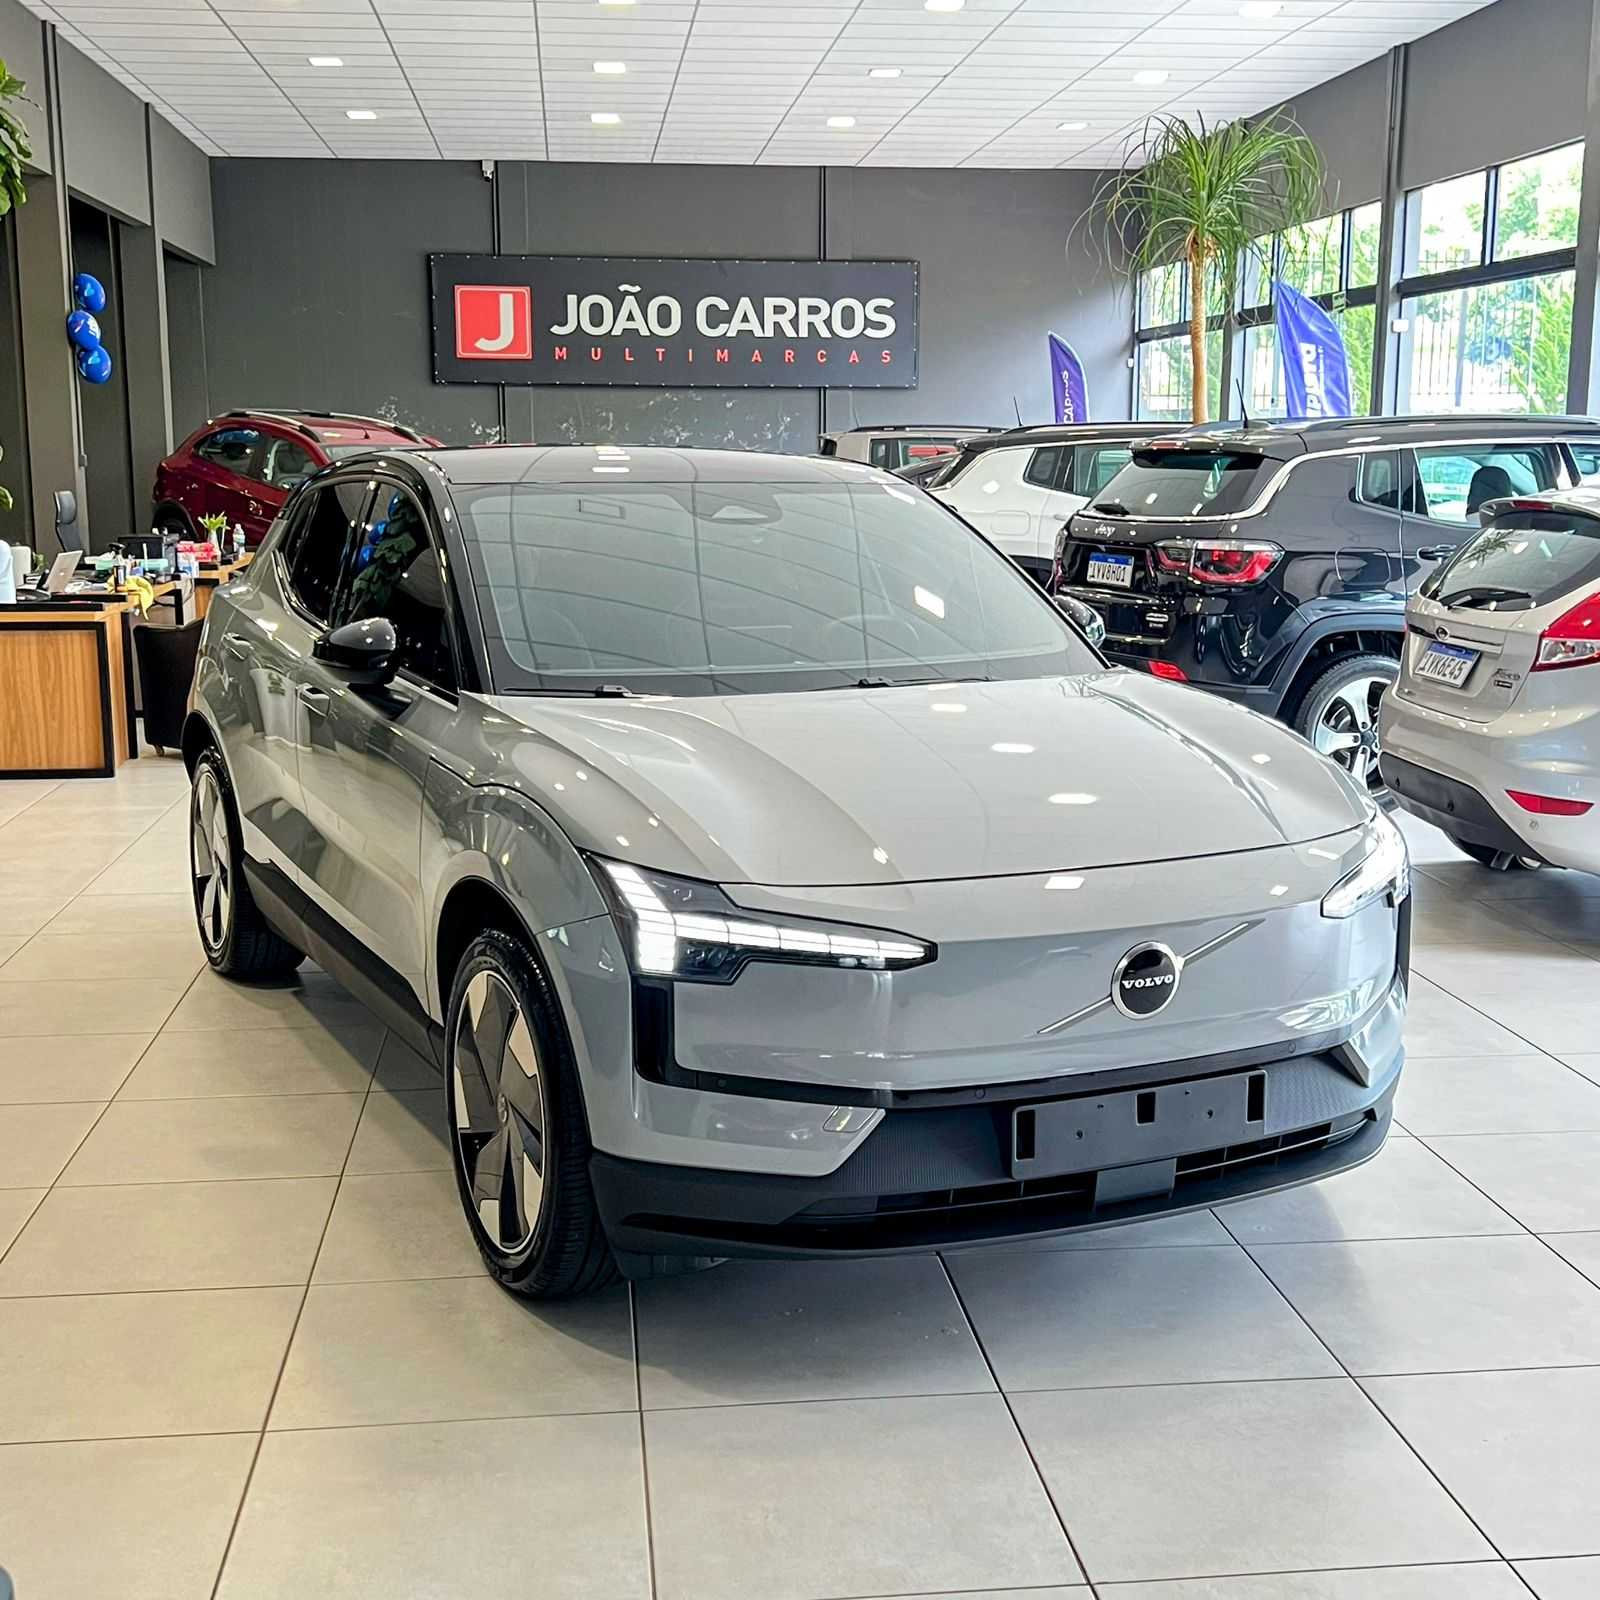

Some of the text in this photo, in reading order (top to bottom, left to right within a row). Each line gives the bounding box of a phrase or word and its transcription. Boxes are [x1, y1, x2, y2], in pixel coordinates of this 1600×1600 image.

[550, 283, 897, 339] JOÃO CARROS
[555, 346, 892, 363] MULTIMARCAS
[1121, 974, 1174, 989] VOLVO
